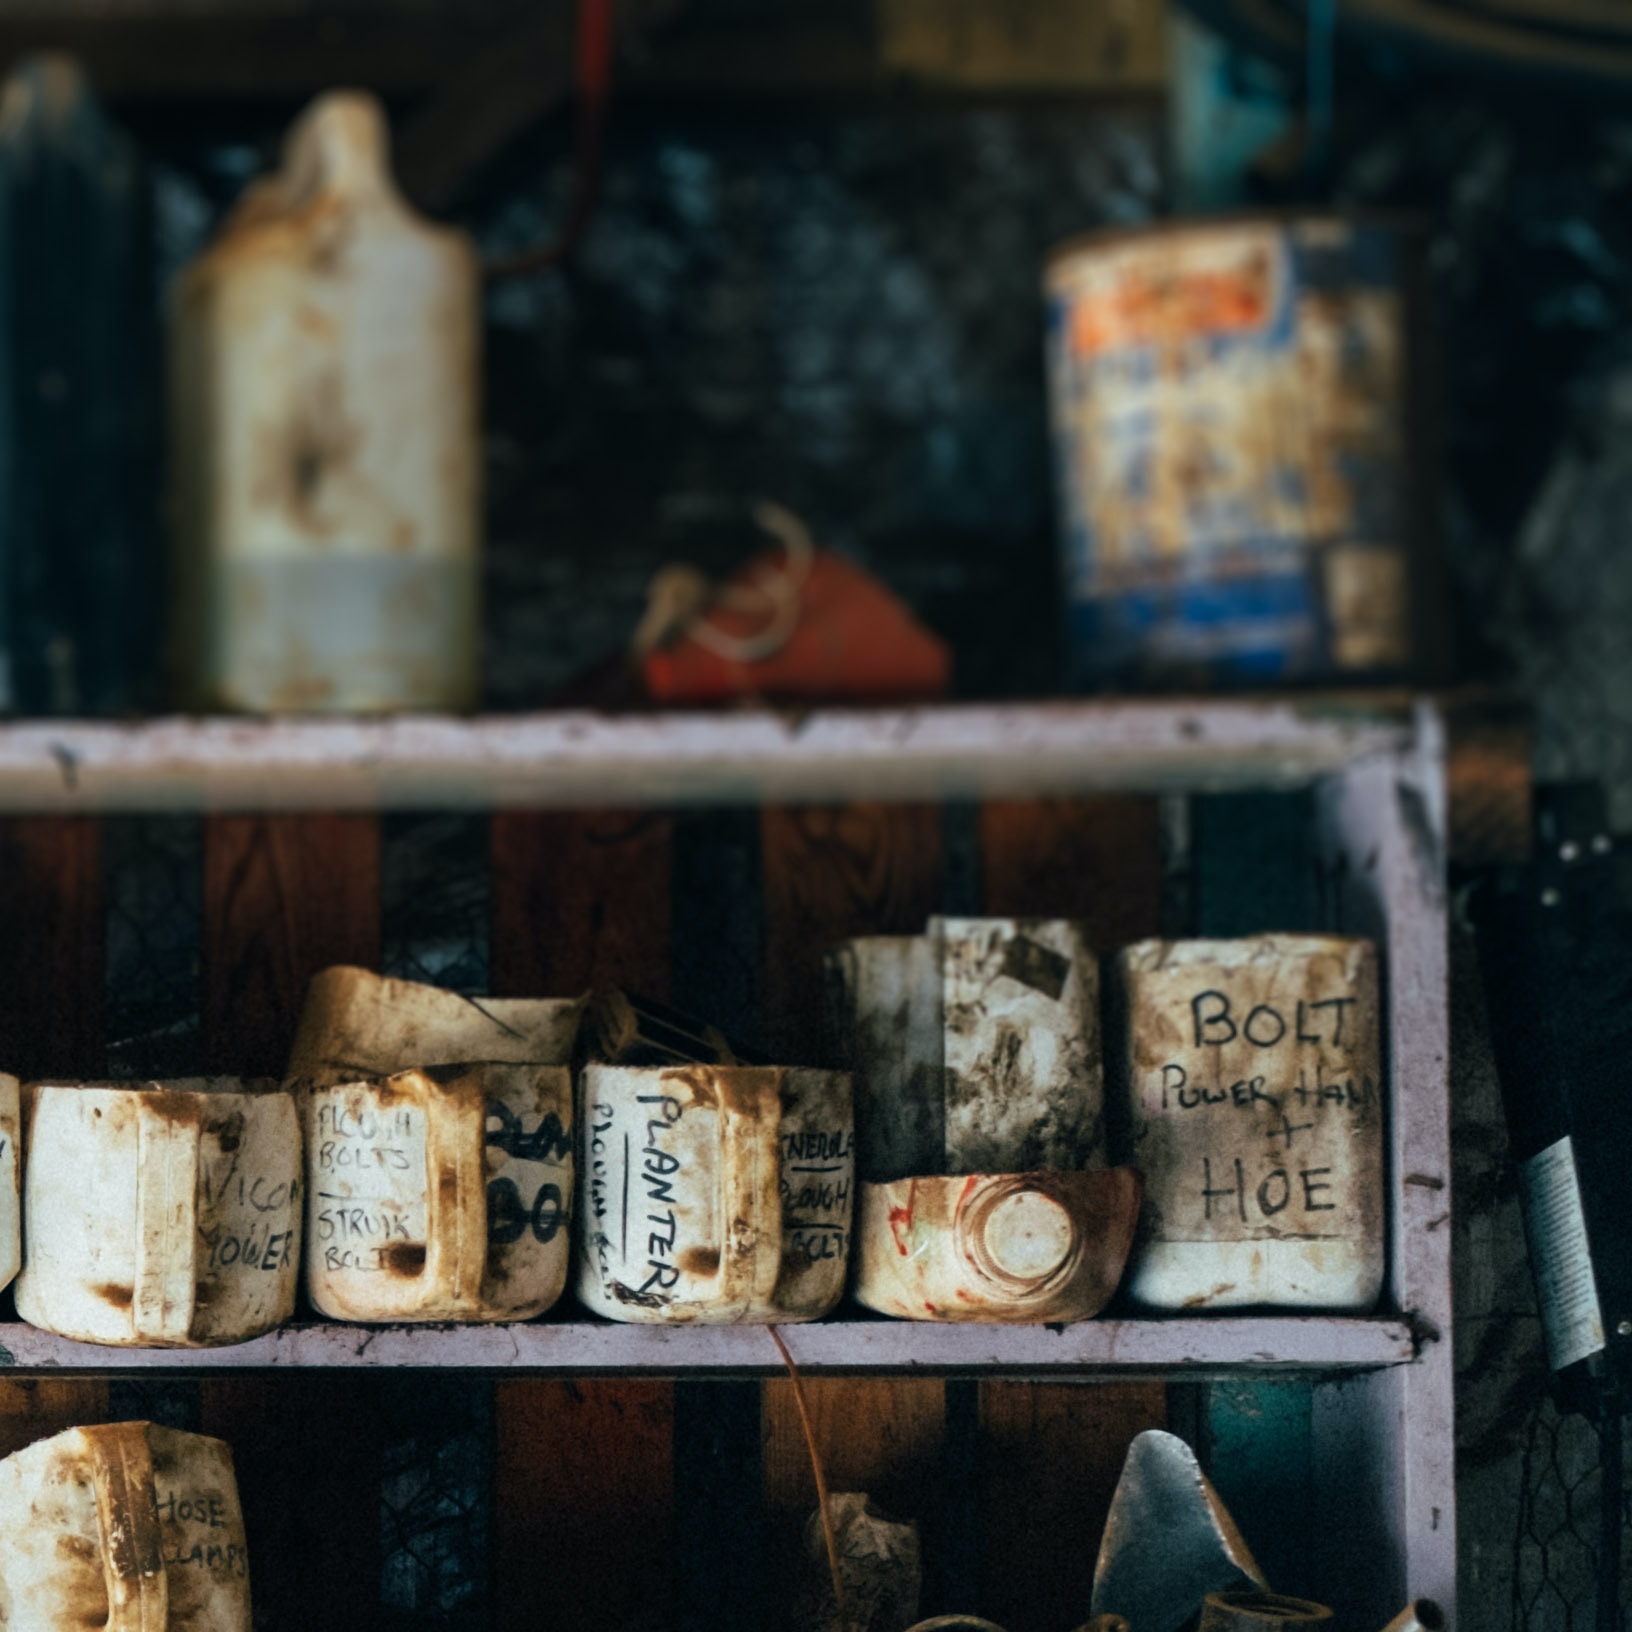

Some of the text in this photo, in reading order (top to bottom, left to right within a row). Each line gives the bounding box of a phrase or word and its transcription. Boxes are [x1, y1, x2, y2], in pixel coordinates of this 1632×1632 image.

[1190, 990, 1356, 1049] BOLT
[318, 1104, 411, 1140] PLOUH
[319, 1140, 410, 1173] BOLTS
[636, 1094, 682, 1294] PLANTER
[1202, 1157, 1335, 1222] HOE
